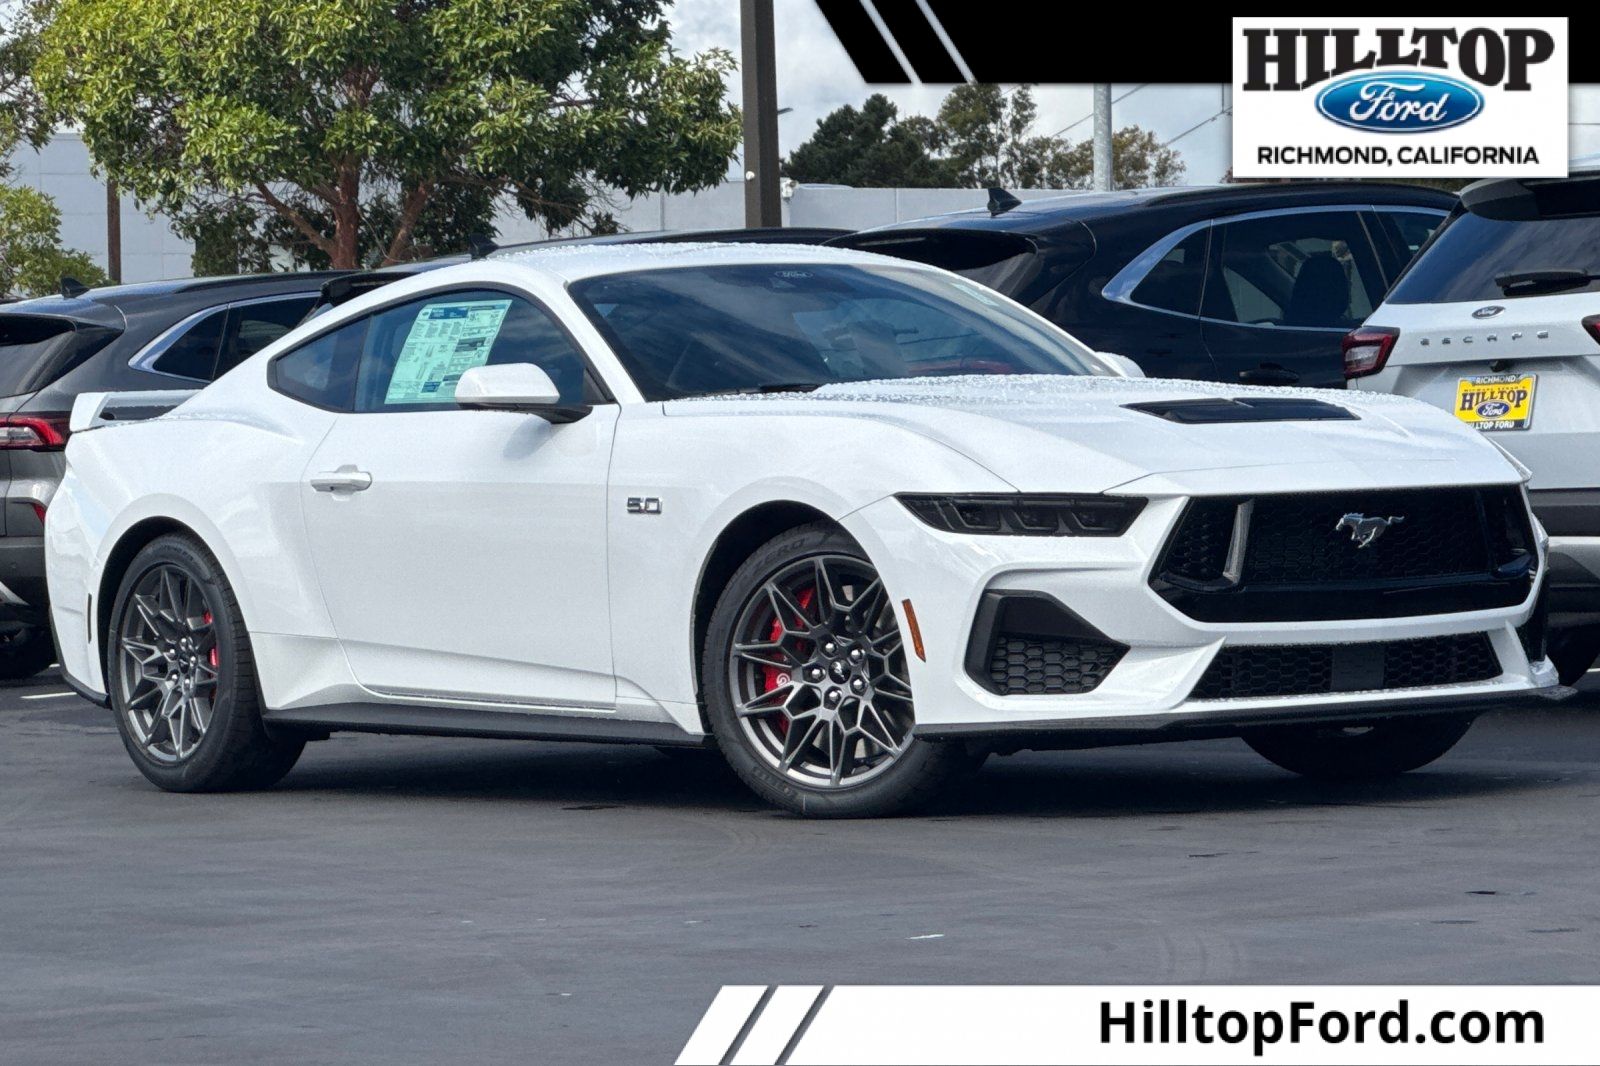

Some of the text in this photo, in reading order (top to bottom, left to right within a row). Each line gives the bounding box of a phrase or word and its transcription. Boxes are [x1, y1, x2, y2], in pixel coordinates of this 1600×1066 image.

[1476, 375, 1516, 384] RICHMOND
[1460, 390, 1527, 411] HILLTOP
[1482, 403, 1504, 416] Ford
[1495, 420, 1515, 429] FORD
